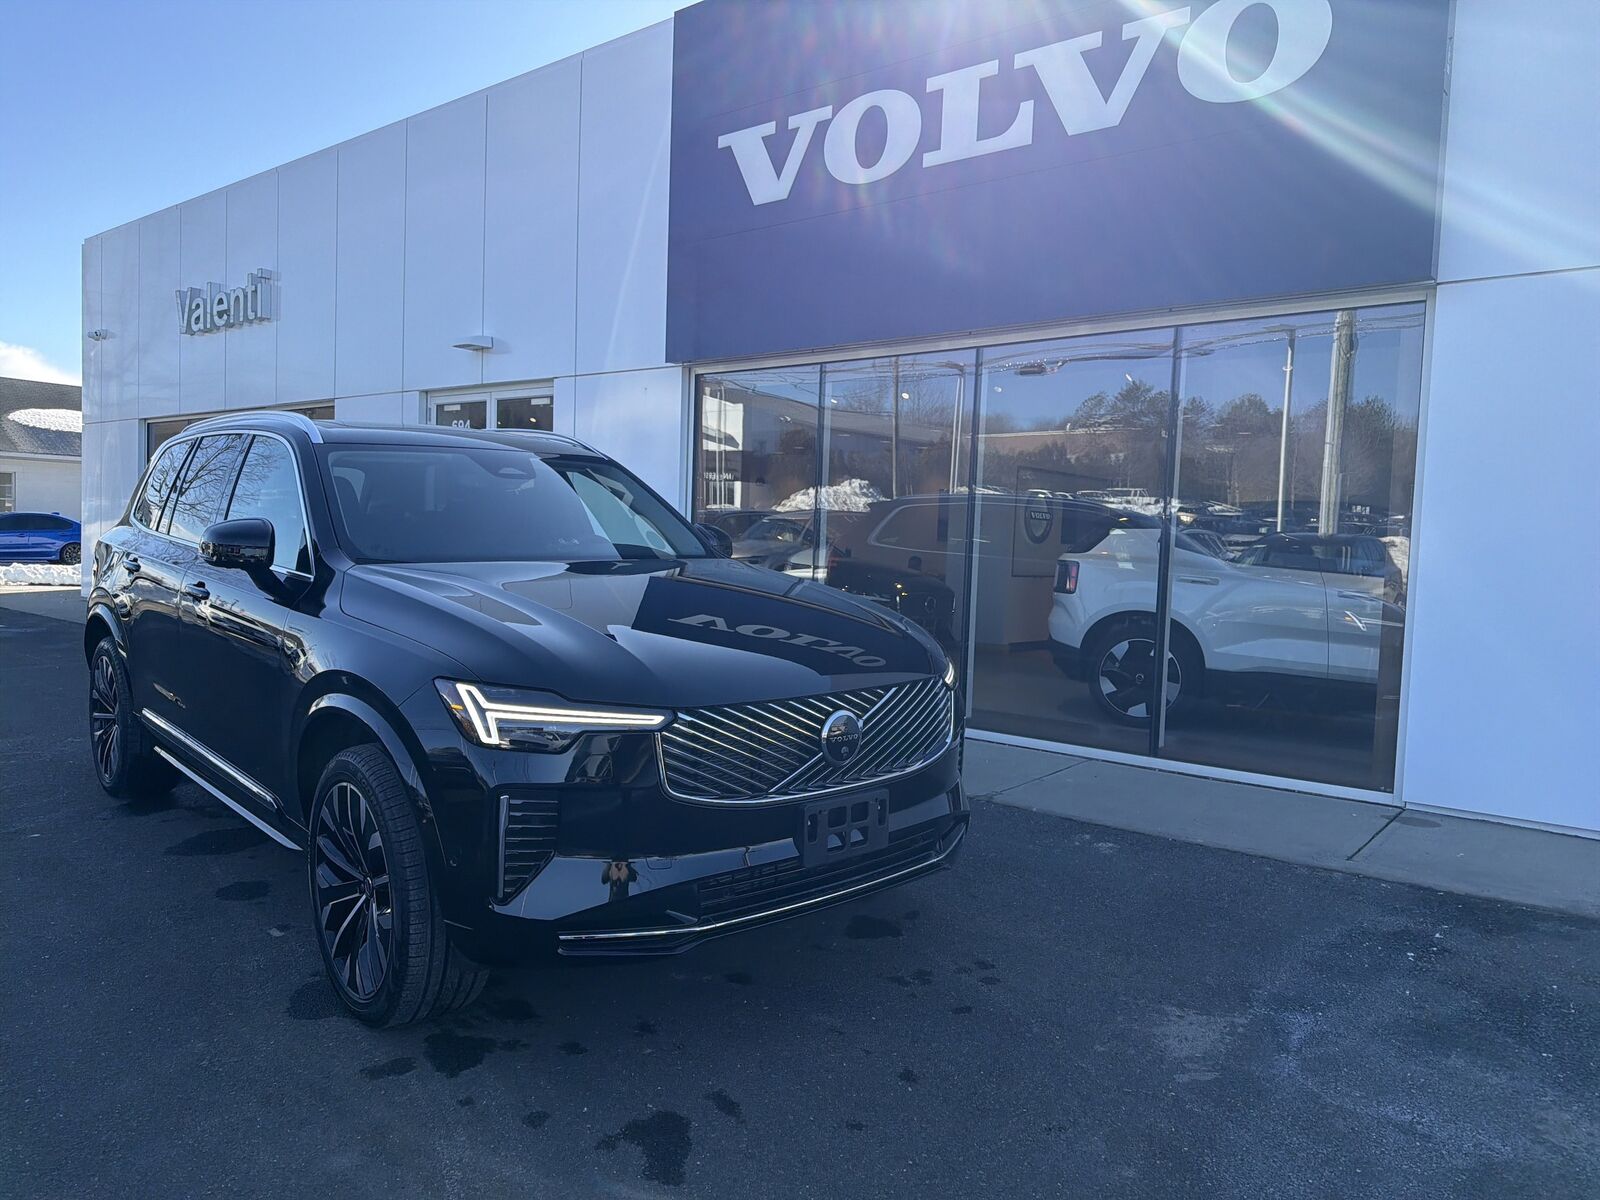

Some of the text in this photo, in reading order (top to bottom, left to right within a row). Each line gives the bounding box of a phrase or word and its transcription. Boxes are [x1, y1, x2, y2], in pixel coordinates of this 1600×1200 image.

[718, 0, 1333, 206] VOLVO
[175, 268, 272, 335] Valenti
[829, 733, 859, 743] VOLVO
